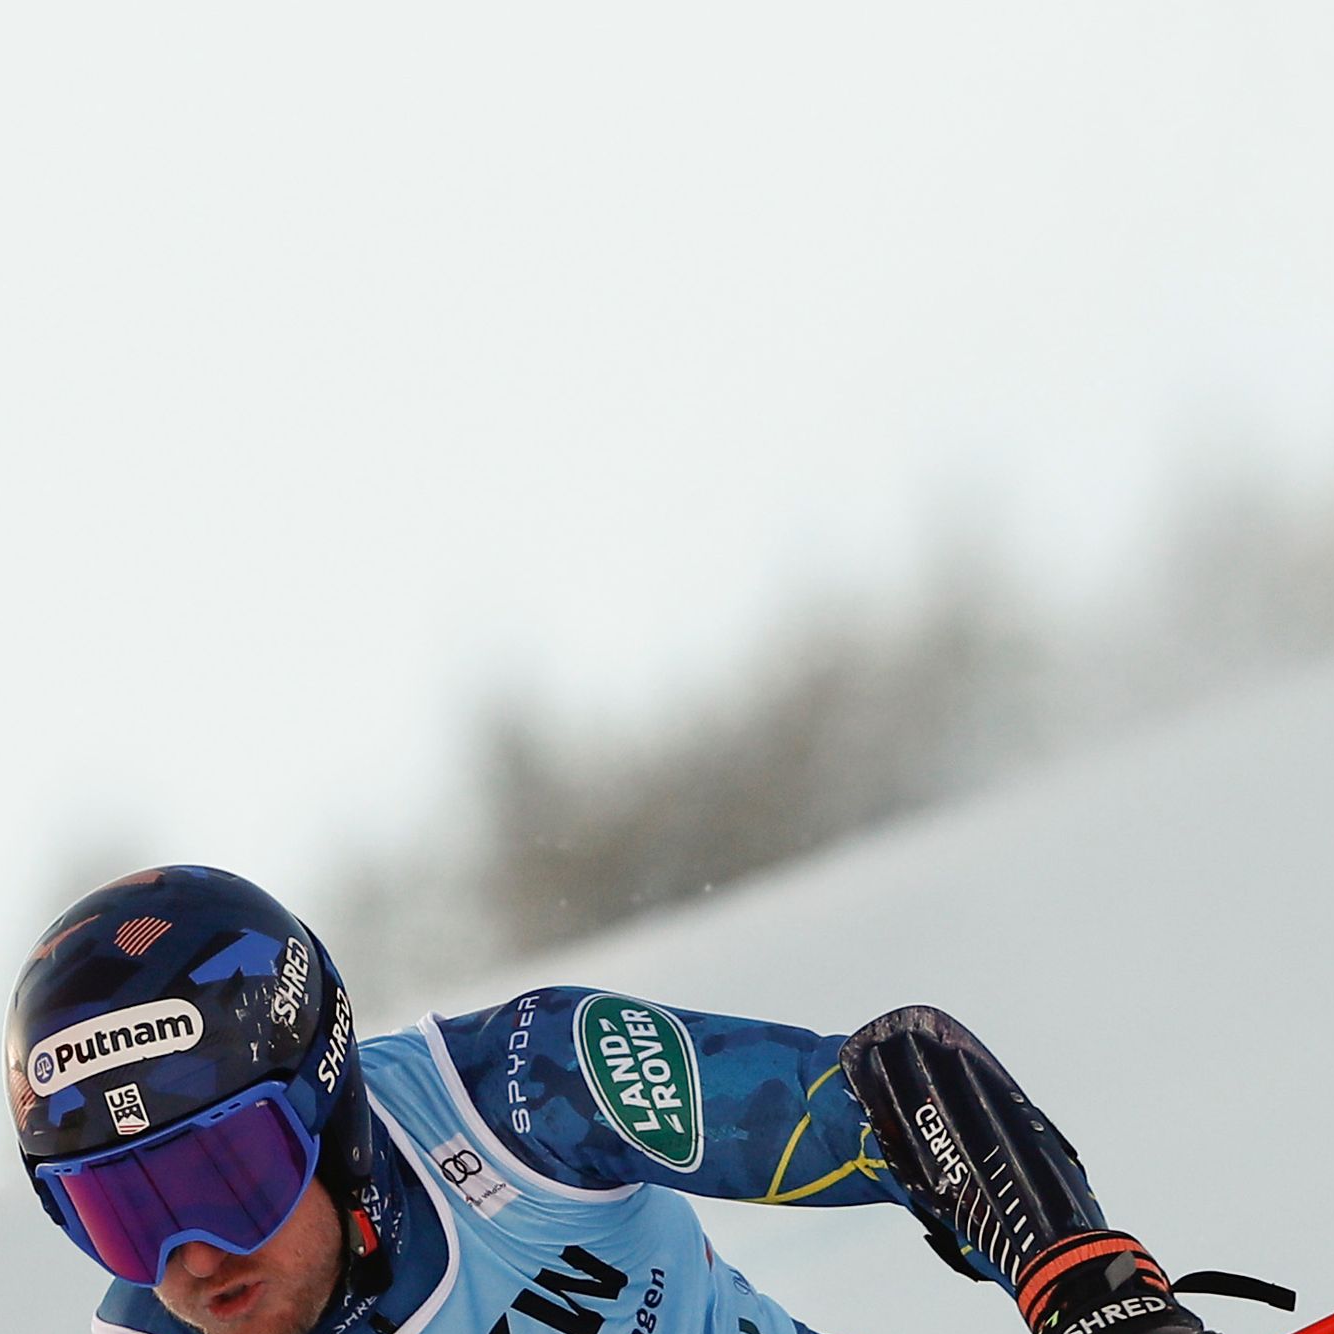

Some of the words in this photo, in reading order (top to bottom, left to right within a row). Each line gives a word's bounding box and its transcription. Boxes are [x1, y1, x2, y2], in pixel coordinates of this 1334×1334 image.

[272, 937, 309, 1025] SHRED
[55, 1014, 194, 1073] Putnam
[318, 987, 352, 1094] SHRED
[507, 995, 540, 1134] SPYDER
[599, 1034, 661, 1132] LAND
[620, 1009, 683, 1110] ROVER
[109, 1089, 138, 1109] US
